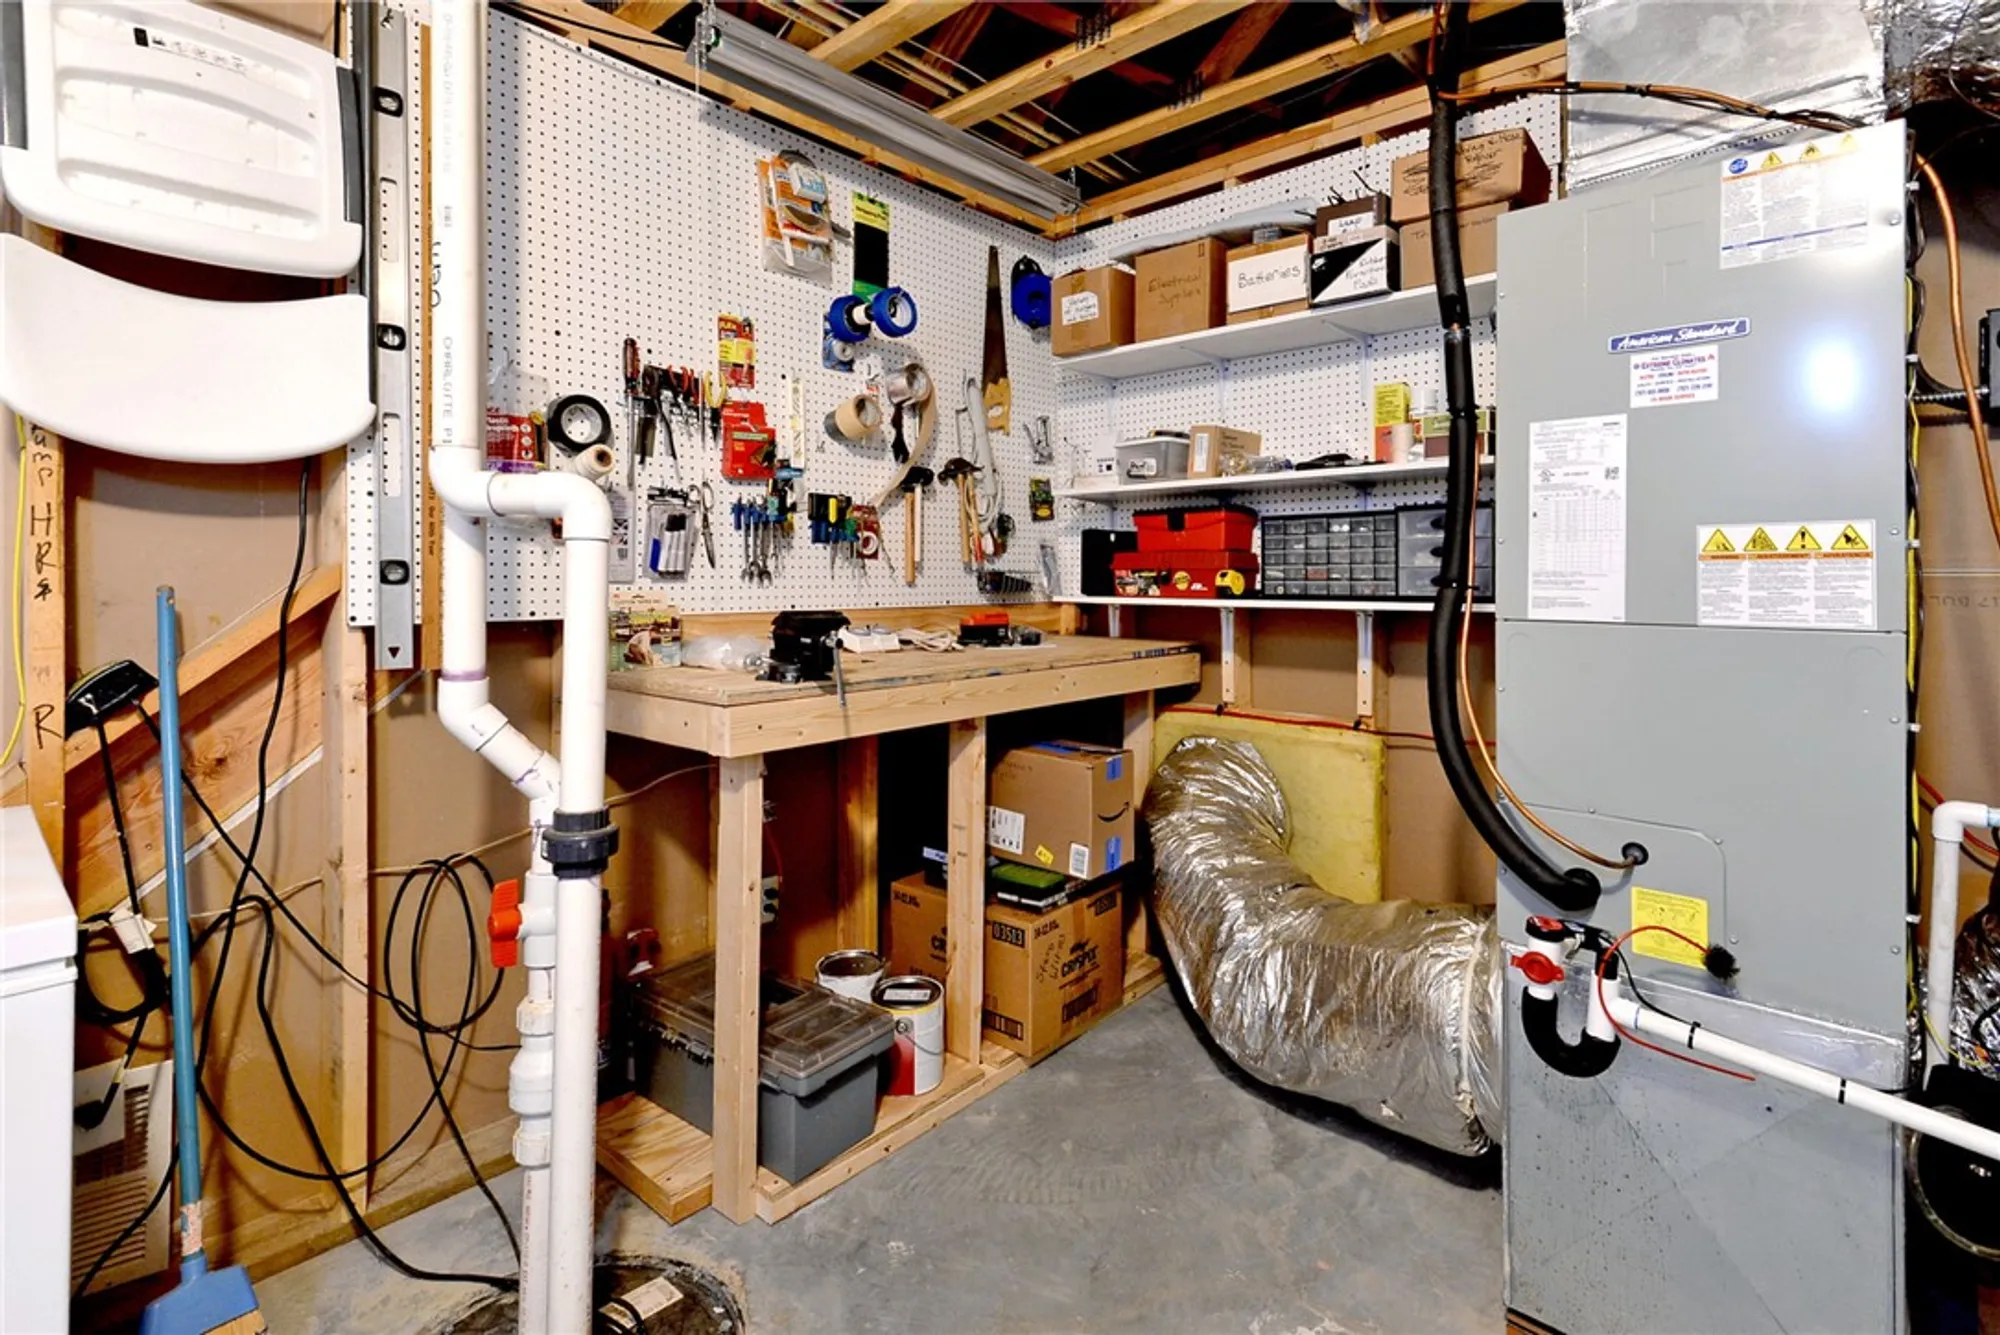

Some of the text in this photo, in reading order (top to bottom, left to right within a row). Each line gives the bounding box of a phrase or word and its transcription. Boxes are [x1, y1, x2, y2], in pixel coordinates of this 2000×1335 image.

[1238, 265, 1301, 289] Batteries
[1617, 320, 1739, 350] American Standard
